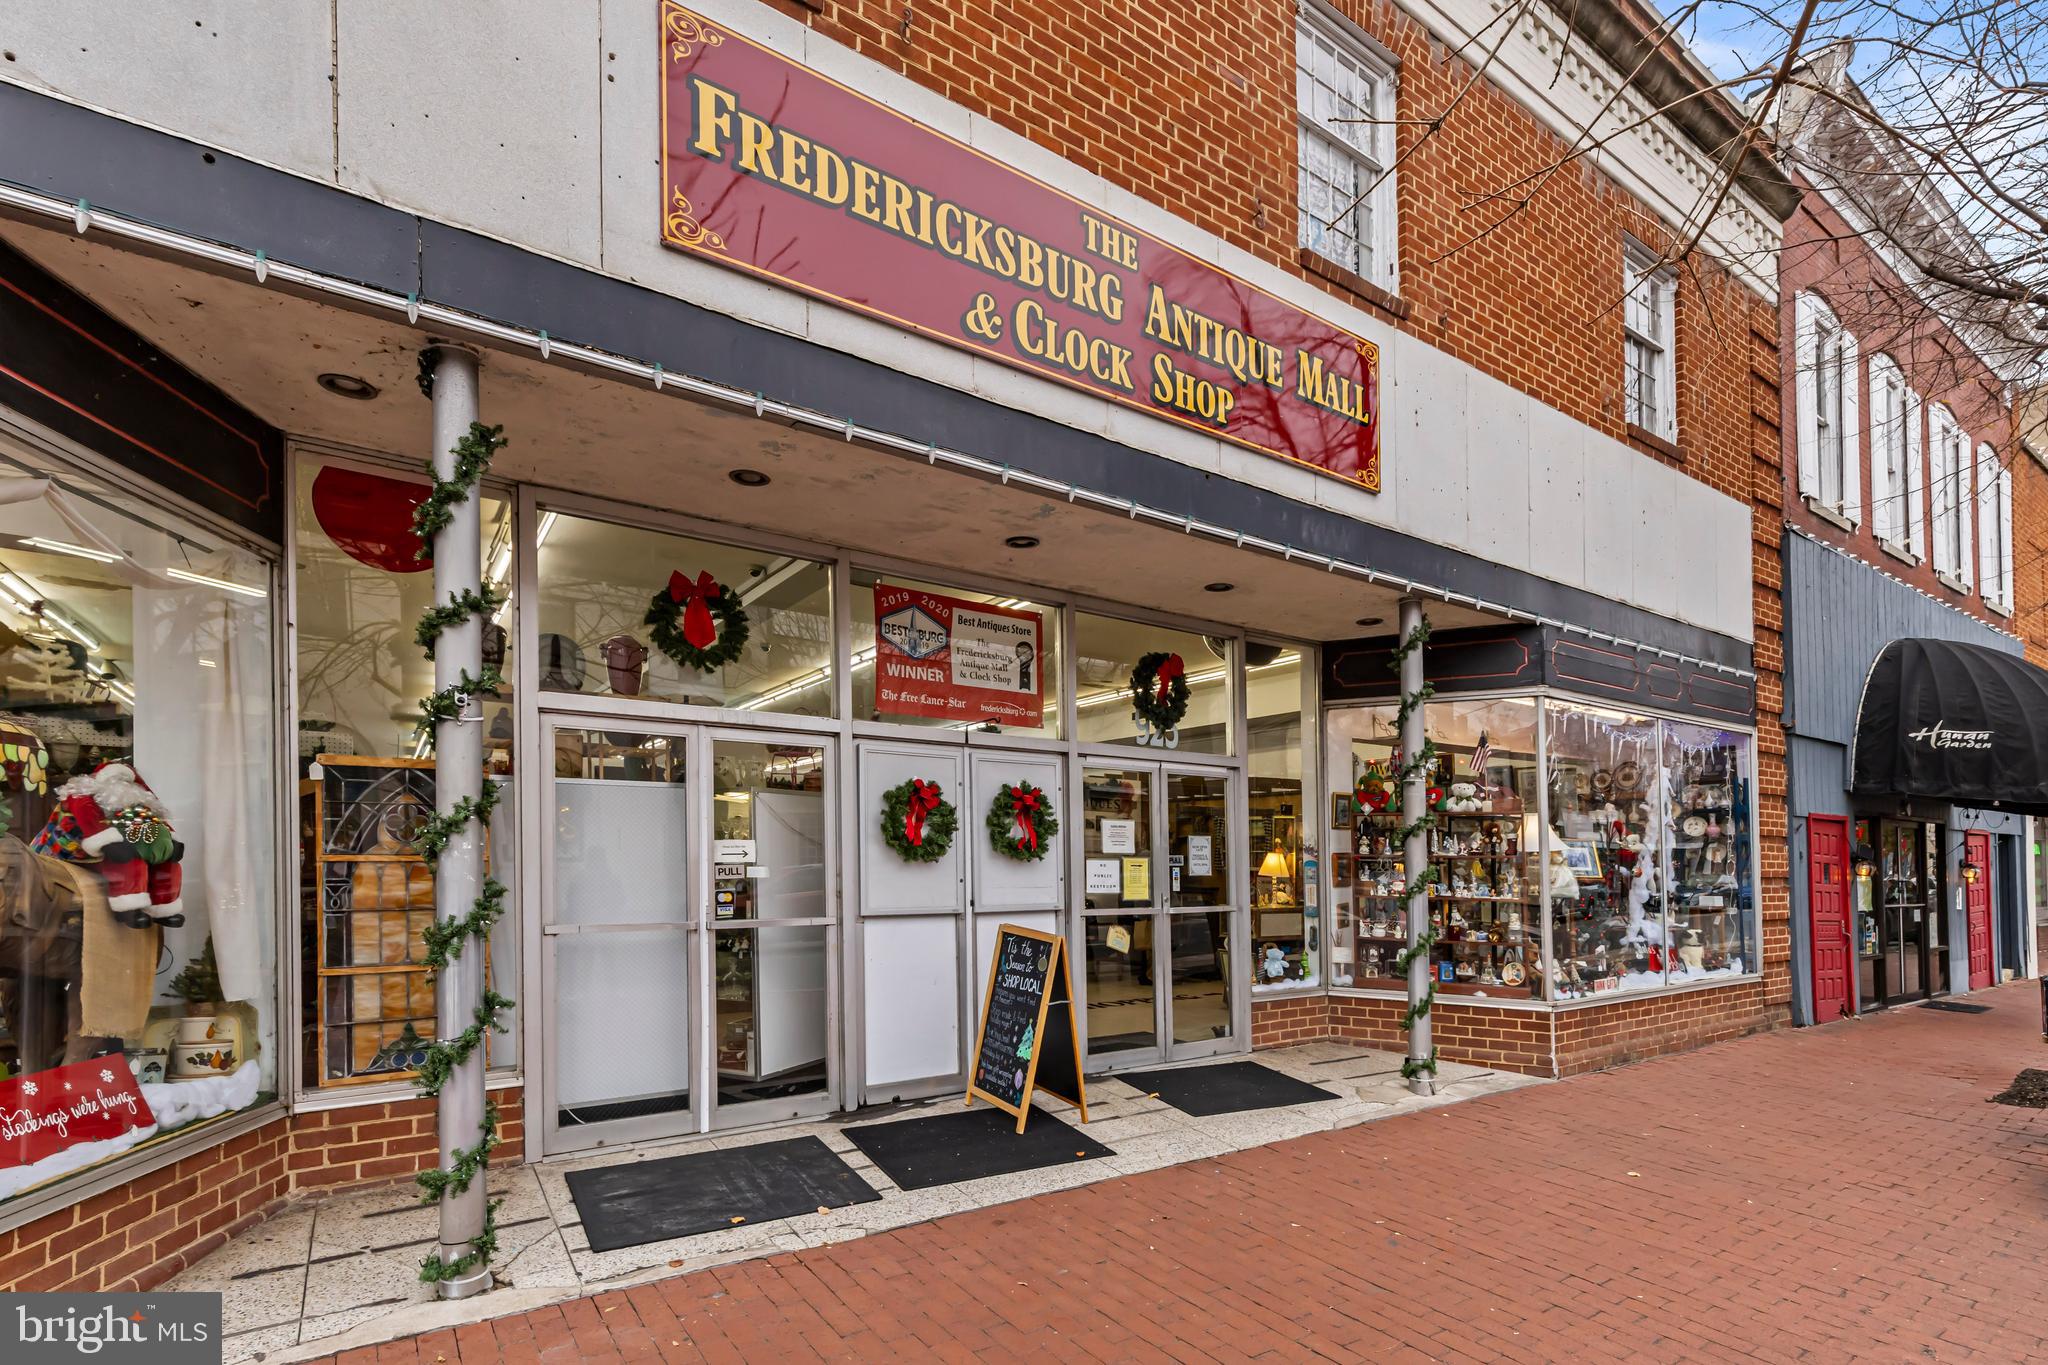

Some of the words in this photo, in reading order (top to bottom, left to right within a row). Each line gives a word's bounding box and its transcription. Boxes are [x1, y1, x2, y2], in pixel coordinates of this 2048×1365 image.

[692, 77, 1123, 321] FREDERICKSBURG
[1145, 283, 1284, 389] ANTIQUE
[1299, 349, 1369, 425] MALL
[1082, 213, 1138, 272] THE
[966, 293, 1002, 339] &
[1016, 301, 1134, 390] CLOCK
[1152, 353, 1235, 425] SHOP
[881, 592, 909, 607] 2019
[921, 595, 949, 618] 2020
[884, 623, 909, 637] BEST
[918, 629, 944, 644] BURG
[957, 614, 976, 627] Best
[976, 617, 1010, 633] Antiques
[1011, 624, 1032, 636] Store
[899, 637, 908, 645] 20
[976, 638, 990, 648] The
[956, 647, 1013, 665] Fredericksburg
[960, 660, 989, 671] Antique
[991, 663, 1008, 672] Mall
[886, 662, 945, 683] WINNER
[959, 670, 967, 678] &
[969, 670, 991, 682] Clock
[993, 674, 1012, 686] Shop
[881, 689, 898, 701] The
[899, 691, 919, 703] Free
[919, 693, 967, 709] Lance-Star
[1908, 720, 1995, 749] Hunan
[1936, 738, 1992, 748] Garden
[717, 867, 742, 876] PULL
[1021, 940, 1032, 956] the
[1026, 957, 1035, 972] to
[1003, 974, 1020, 988] SHOP
[1020, 977, 1042, 995] LOCAL
[0, 1107, 69, 1140] stockings
[71, 1096, 99, 1118] were
[97, 1088, 136, 1115] hung
